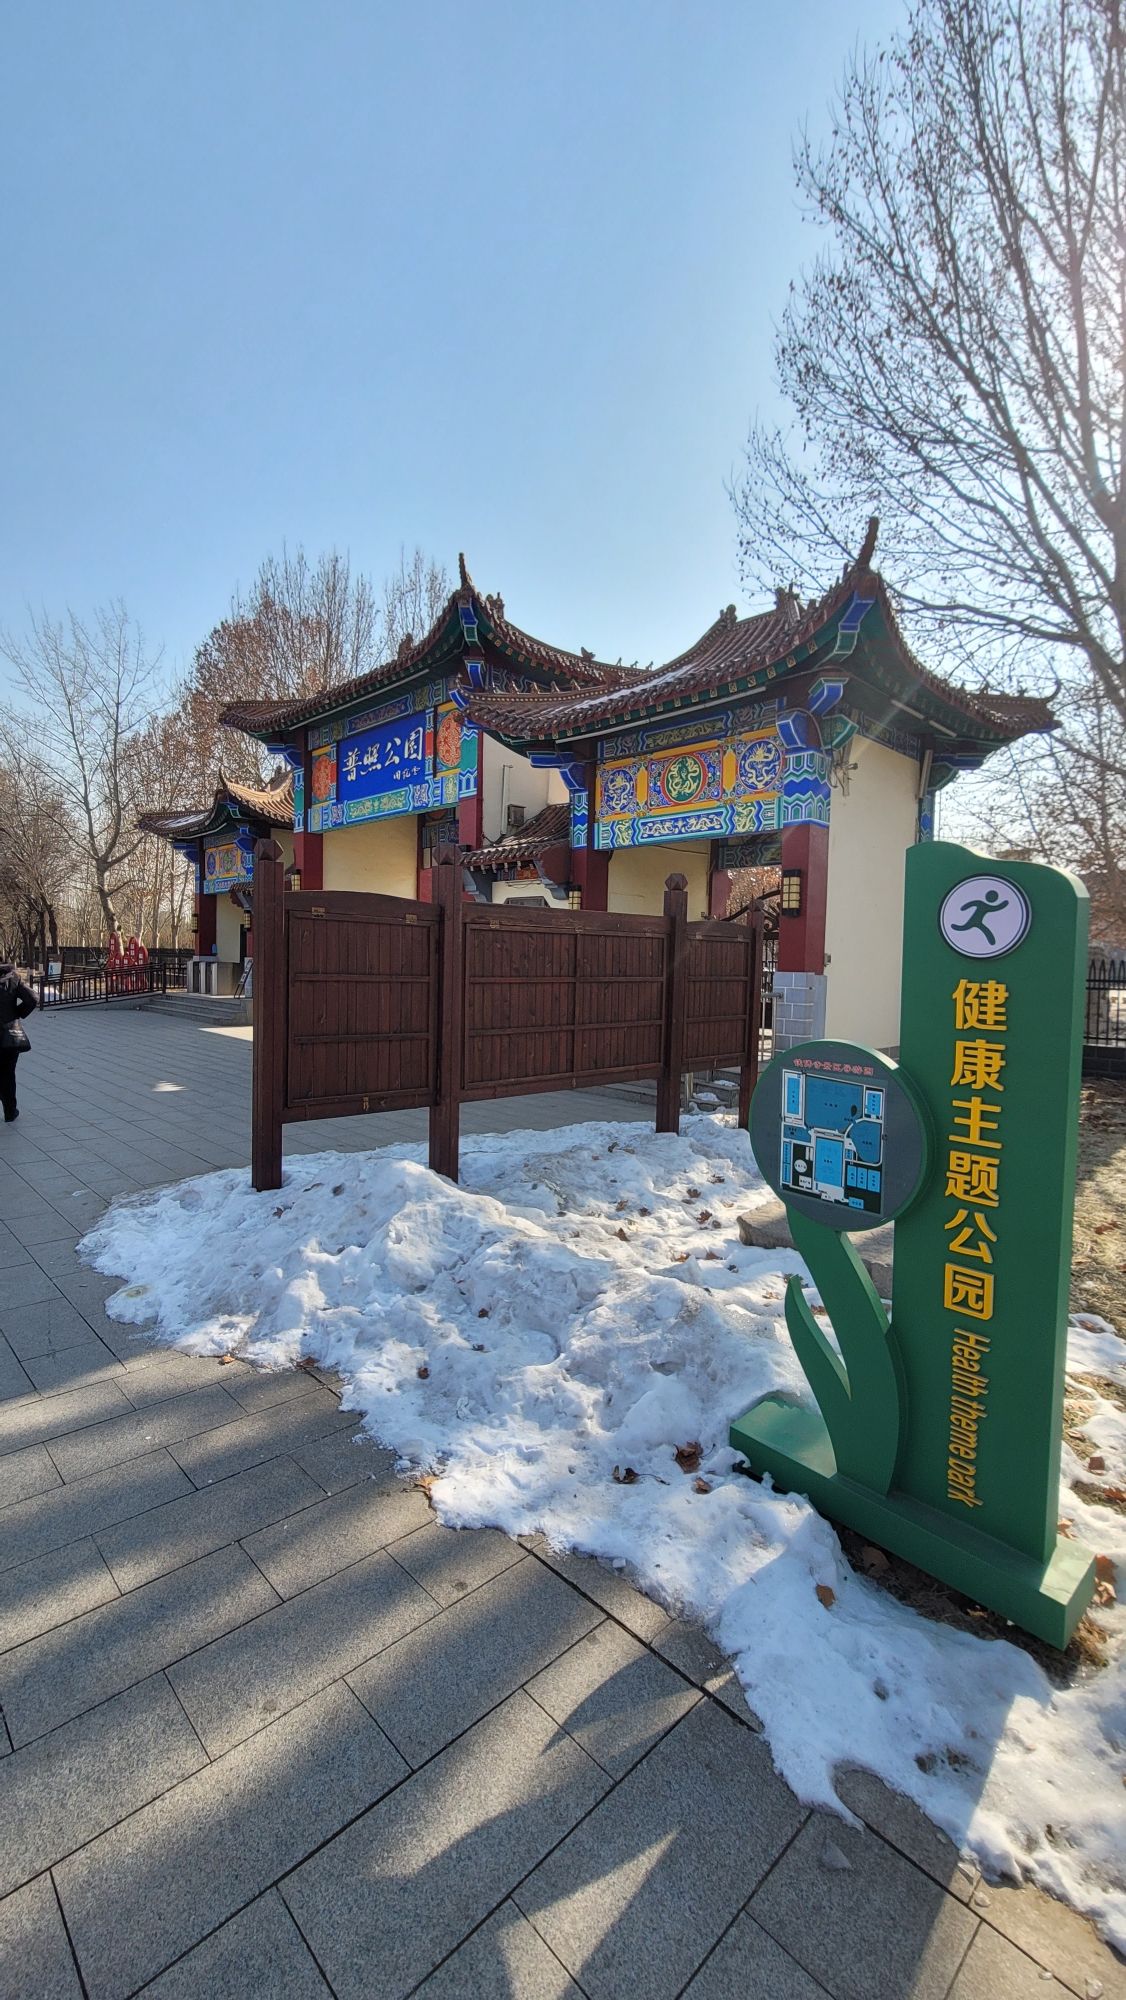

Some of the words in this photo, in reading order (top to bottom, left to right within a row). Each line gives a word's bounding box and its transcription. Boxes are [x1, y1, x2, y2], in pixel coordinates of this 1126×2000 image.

[943, 978, 1010, 1321] 健康主题公园
[953, 1327, 992, 1397] Health
[949, 1394, 988, 1460] theme
